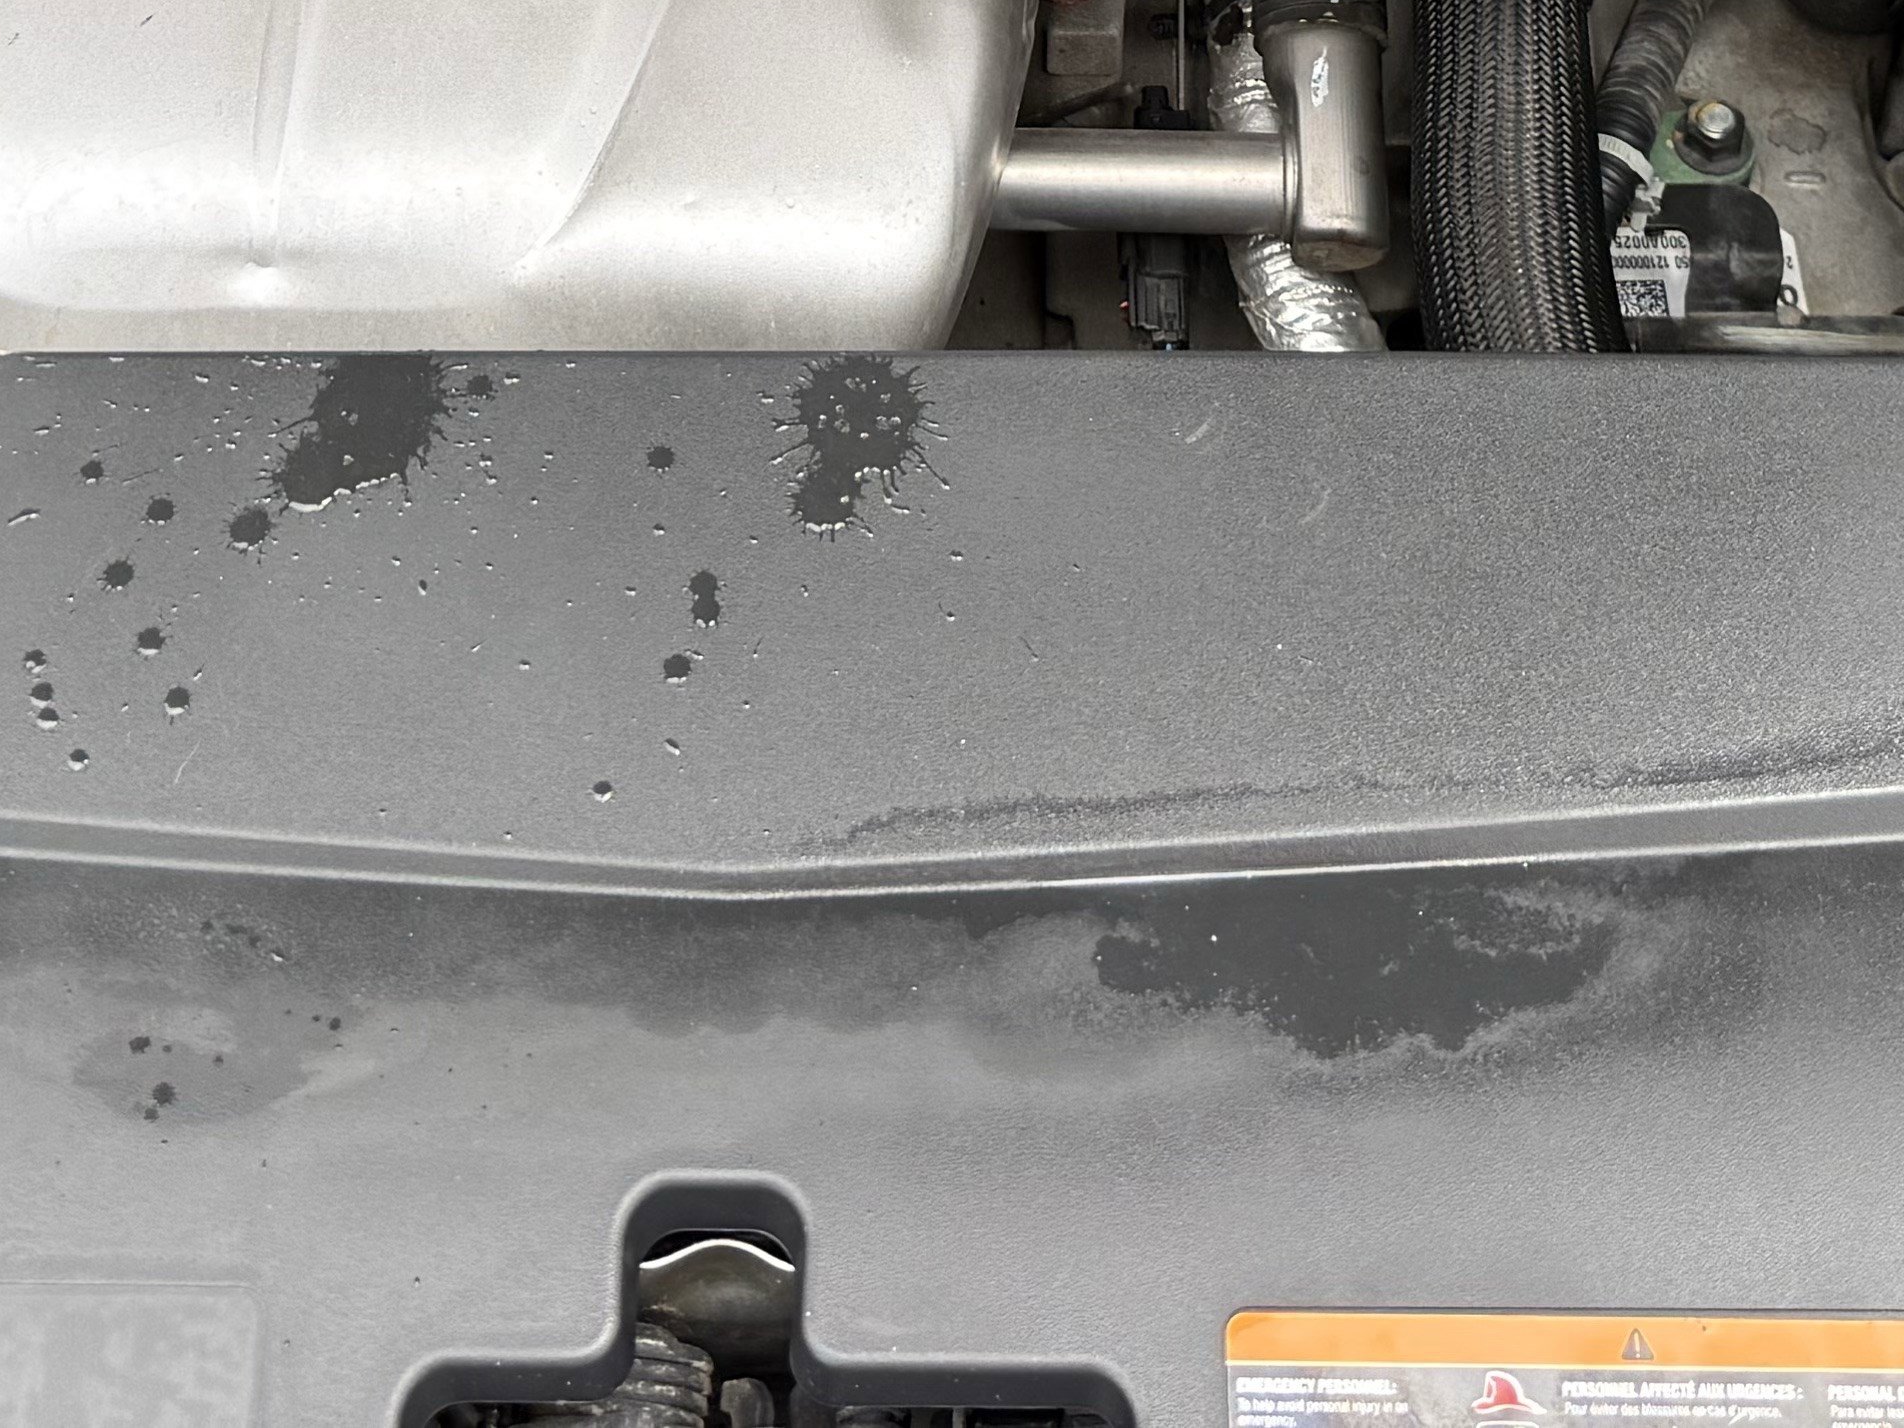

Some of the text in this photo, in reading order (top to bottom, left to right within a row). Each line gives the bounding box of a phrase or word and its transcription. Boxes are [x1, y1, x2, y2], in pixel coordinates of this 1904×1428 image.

[1236, 1376, 1398, 1395] EMERGENCY PERSONNEL:
[1306, 1400, 1350, 1415] personal
[1352, 1401, 1382, 1416] injury
[1829, 1405, 1854, 1418] Para
